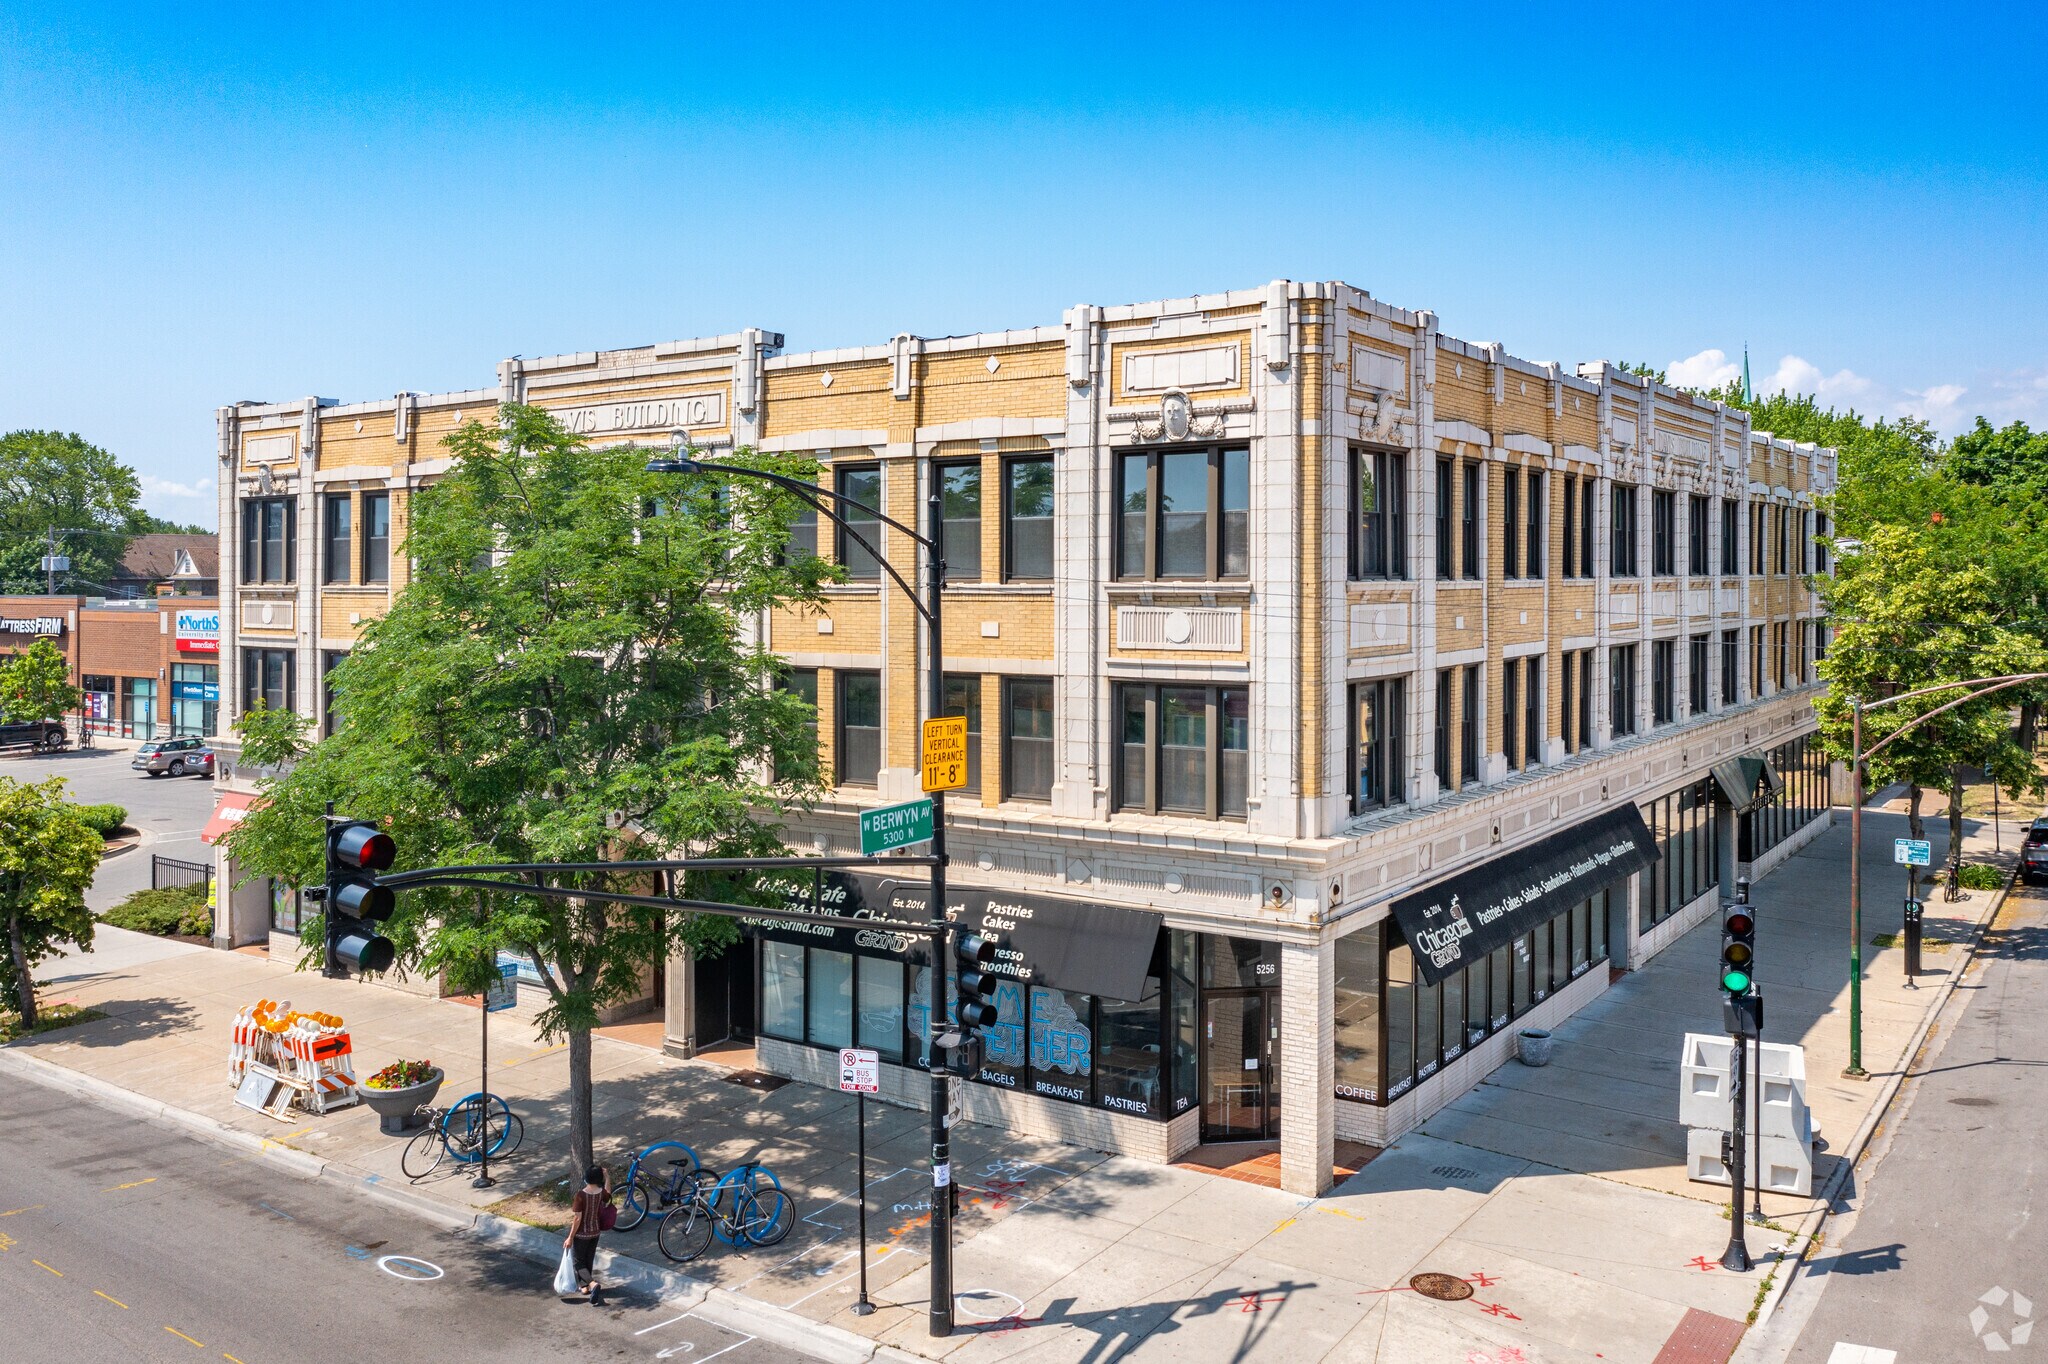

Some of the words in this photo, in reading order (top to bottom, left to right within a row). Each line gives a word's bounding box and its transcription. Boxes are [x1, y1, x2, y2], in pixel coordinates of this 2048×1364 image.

[561, 409, 597, 434] AVIS
[613, 400, 707, 430] BUILDING
[185, 615, 219, 631] NorthS
[190, 640, 215, 649] Immediate
[927, 725, 943, 738] LEFT
[946, 723, 963, 736] TURN
[929, 738, 960, 750] VERTICAL
[925, 750, 964, 765] CLEARANCE
[863, 819, 870, 832] W
[872, 806, 919, 832] BERWYN
[921, 806, 930, 819] AV
[883, 829, 904, 845] 5300
[908, 827, 914, 838] N
[1476, 904, 1504, 926] Pastries
[1503, 896, 1523, 912] Cakes
[1521, 885, 1542, 903] Salads
[1541, 871, 1572, 893] Sandwiches
[1570, 857, 1597, 878] Flatbreads
[1595, 851, 1612, 866] Vegan
[1610, 844, 1626, 858] Gluten
[1622, 840, 1635, 851] Free
[818, 884, 847, 903] afe
[905, 899, 926, 911] 2014
[986, 901, 1034, 919] Pastries
[1430, 904, 1442, 915] 2014
[982, 915, 1016, 930] Cakes
[854, 930, 909, 953] GRIND
[980, 928, 999, 943] Tea
[1416, 922, 1463, 955] Chicago
[994, 948, 1024, 962] resso
[980, 961, 1033, 978] moothies
[1256, 963, 1275, 975] 5256
[1493, 1014, 1507, 1030] SALADS
[913, 1004, 1091, 1068] TETHER
[1471, 1029, 1484, 1044] LUNCH
[1445, 1043, 1461, 1061] BAGELS
[1418, 1059, 1437, 1079] PASTRIES
[856, 1076, 873, 1084] STOP
[982, 1070, 1015, 1086] BAGELS
[1036, 1082, 1084, 1100] BREAKFAST
[1335, 1084, 1377, 1101] COFFEE
[1388, 1076, 1412, 1099] BREAKFAST
[1104, 1095, 1148, 1114] PASTRIES
[1176, 1097, 1188, 1110] TEA
